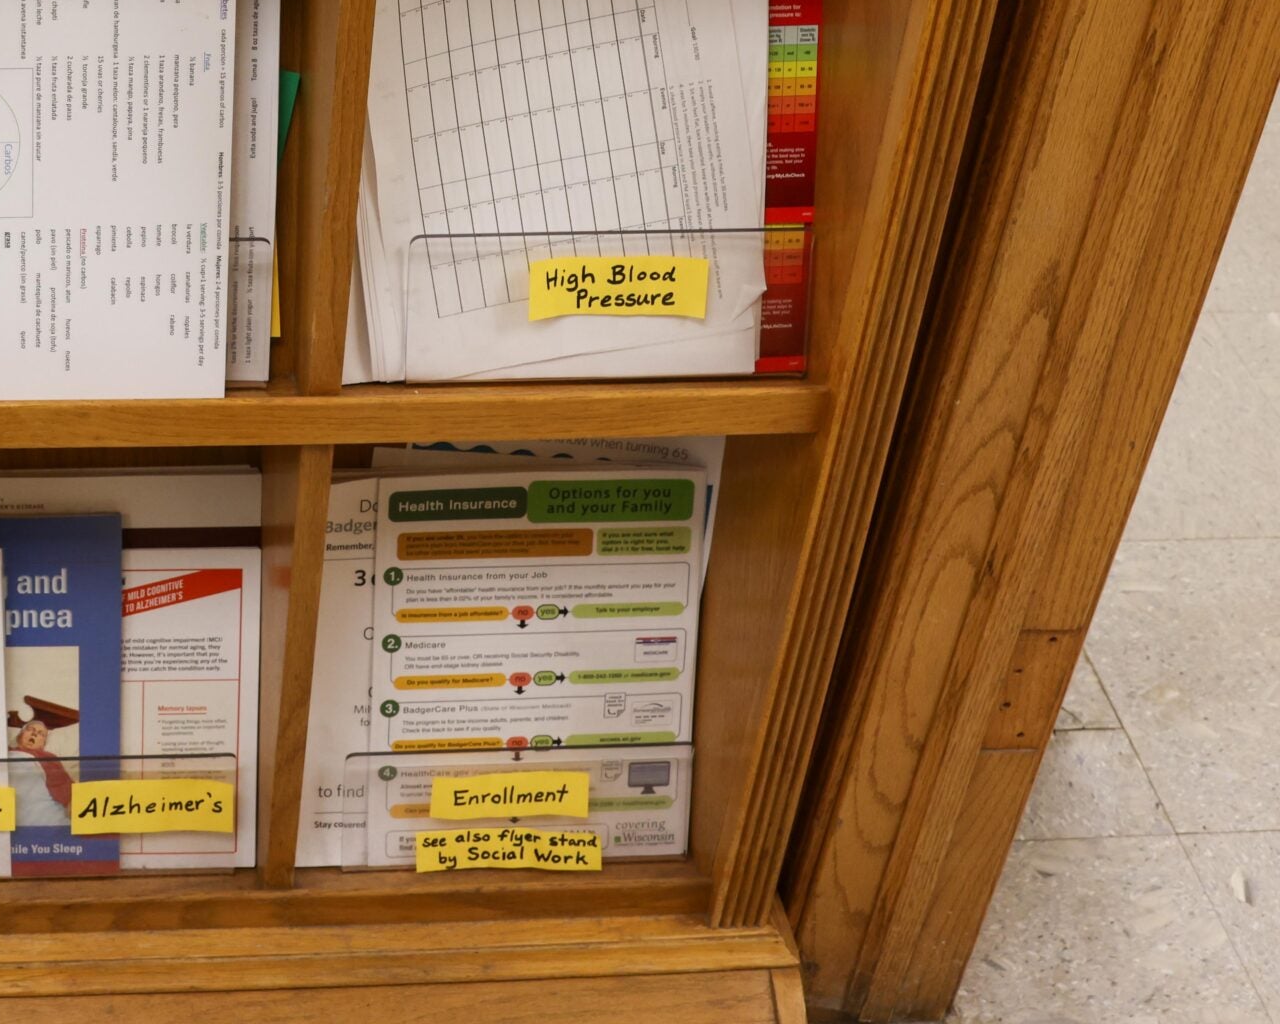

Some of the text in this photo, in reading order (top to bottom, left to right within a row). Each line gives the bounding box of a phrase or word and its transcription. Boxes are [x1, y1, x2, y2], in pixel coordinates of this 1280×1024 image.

[4, 144, 13, 176] Carbos
[546, 264, 676, 292] High Blood
[576, 289, 675, 308] Pressure
[626, 441, 670, 458] turning
[672, 450, 688, 460] 65
[549, 487, 671, 501] Options for you
[398, 498, 517, 512] Health Insurance
[548, 500, 672, 515] and your Family
[17, 568, 67, 594] and
[354, 570, 366, 586] 3
[128, 580, 184, 600] MILD COGNITIVE
[126, 591, 184, 613] TO ALZHEIMER'S
[405, 640, 445, 651] Medicare
[403, 704, 478, 714] BadgerCare Plus
[318, 784, 364, 798] to find
[453, 784, 568, 806] Enrollment
[78, 791, 223, 818] Alzheimer's
[314, 821, 332, 829] Stay
[422, 829, 597, 848] see also flyer stand
[622, 830, 675, 842] Wisconsin
[30, 844, 82, 855] You Sleep
[438, 847, 588, 870] by Social Work
